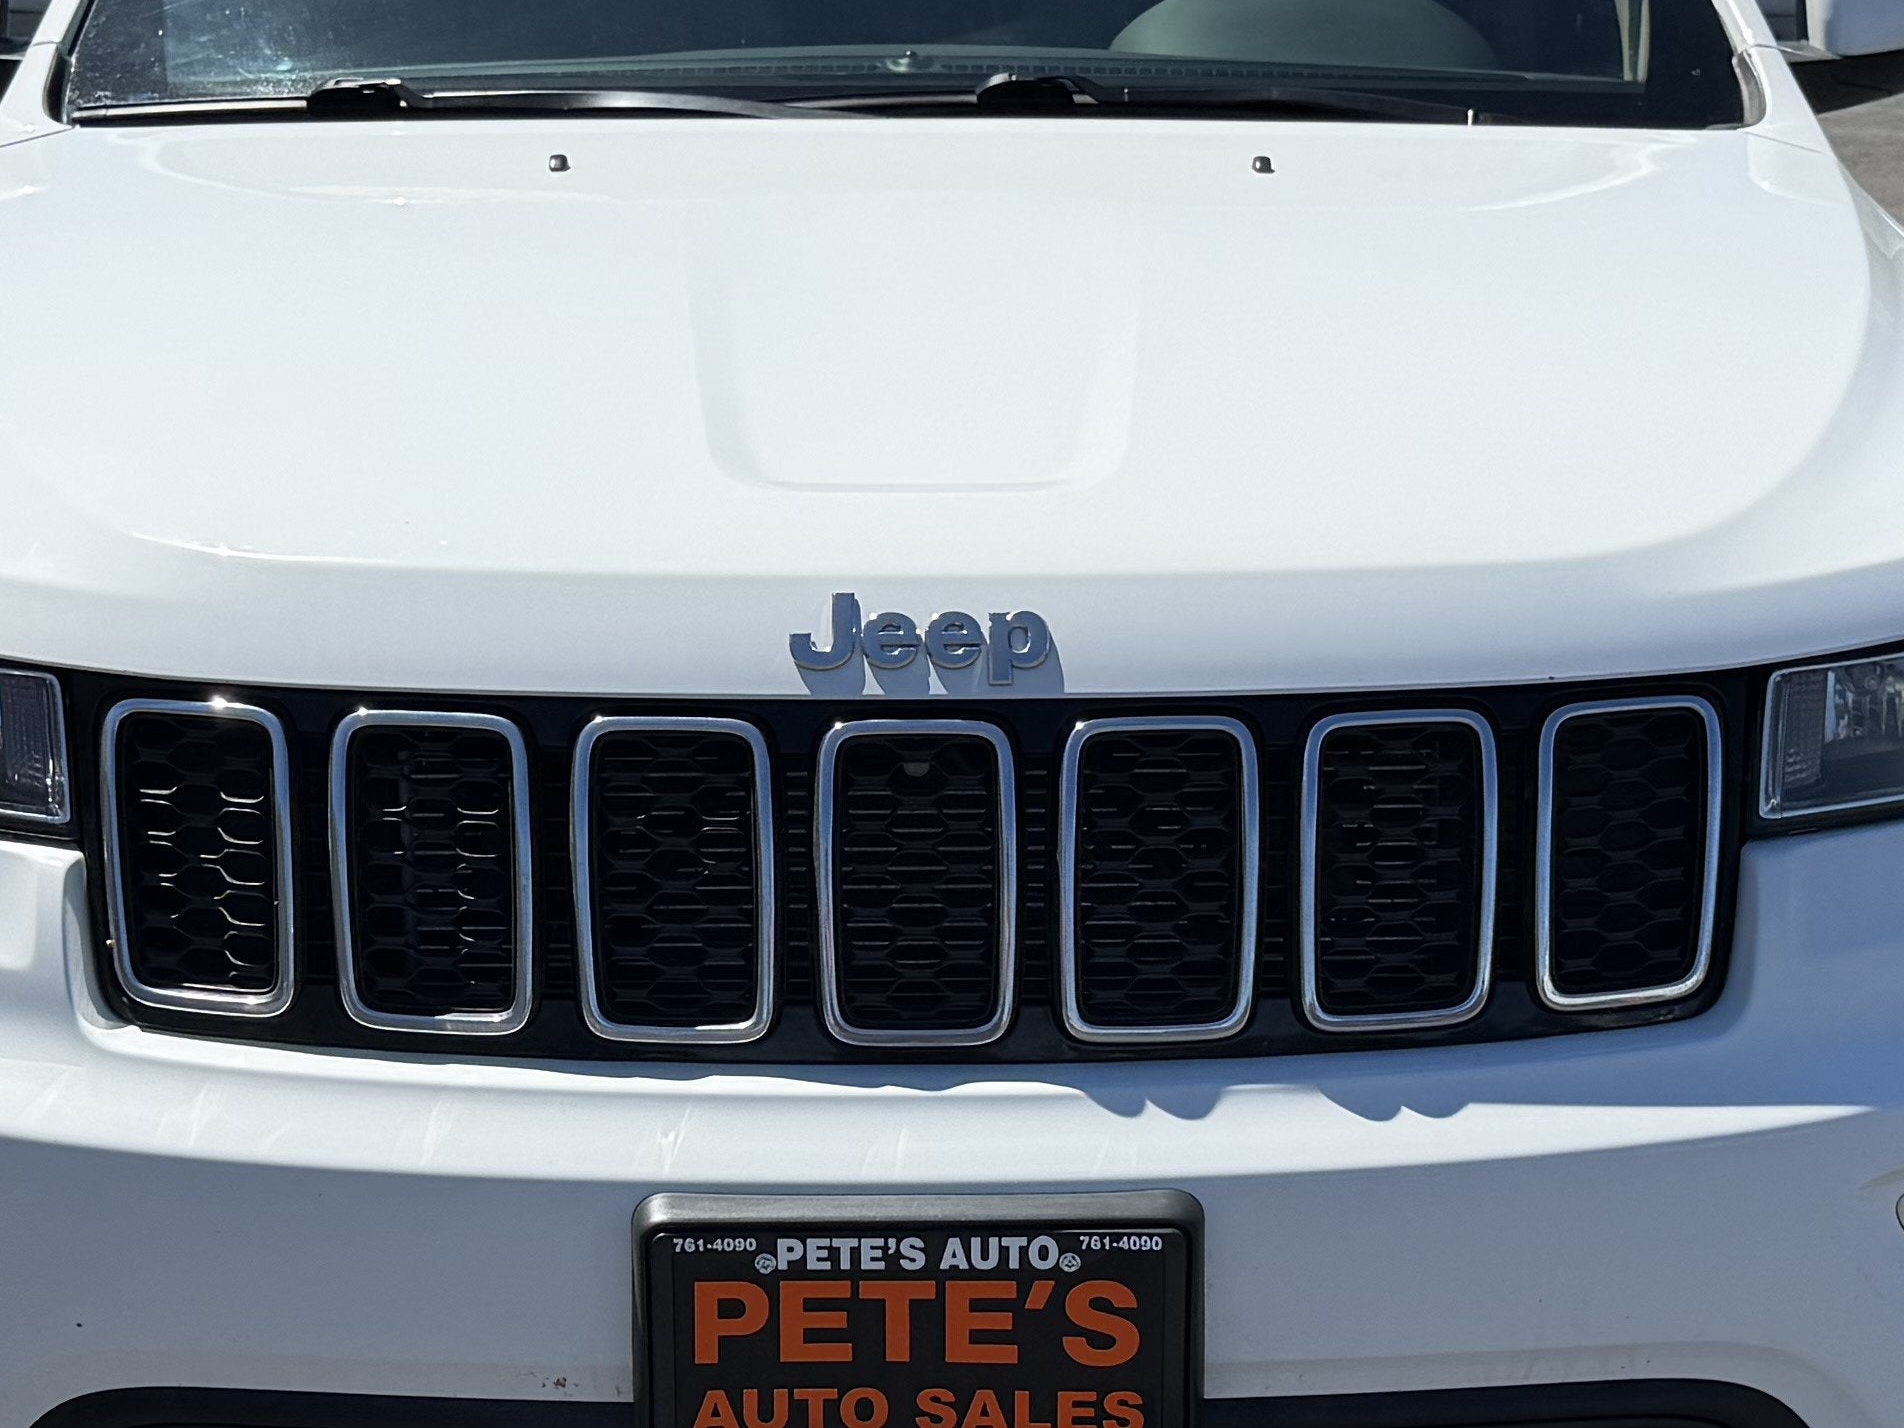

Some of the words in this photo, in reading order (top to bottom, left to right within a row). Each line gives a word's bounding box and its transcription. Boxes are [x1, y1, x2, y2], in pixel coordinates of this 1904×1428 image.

[789, 592, 1050, 686] Jeep
[673, 1237, 757, 1253] 761-4090
[777, 1237, 926, 1271] PETE'S
[940, 1235, 1059, 1270] AUTO
[694, 1280, 1141, 1368] PETE'S
